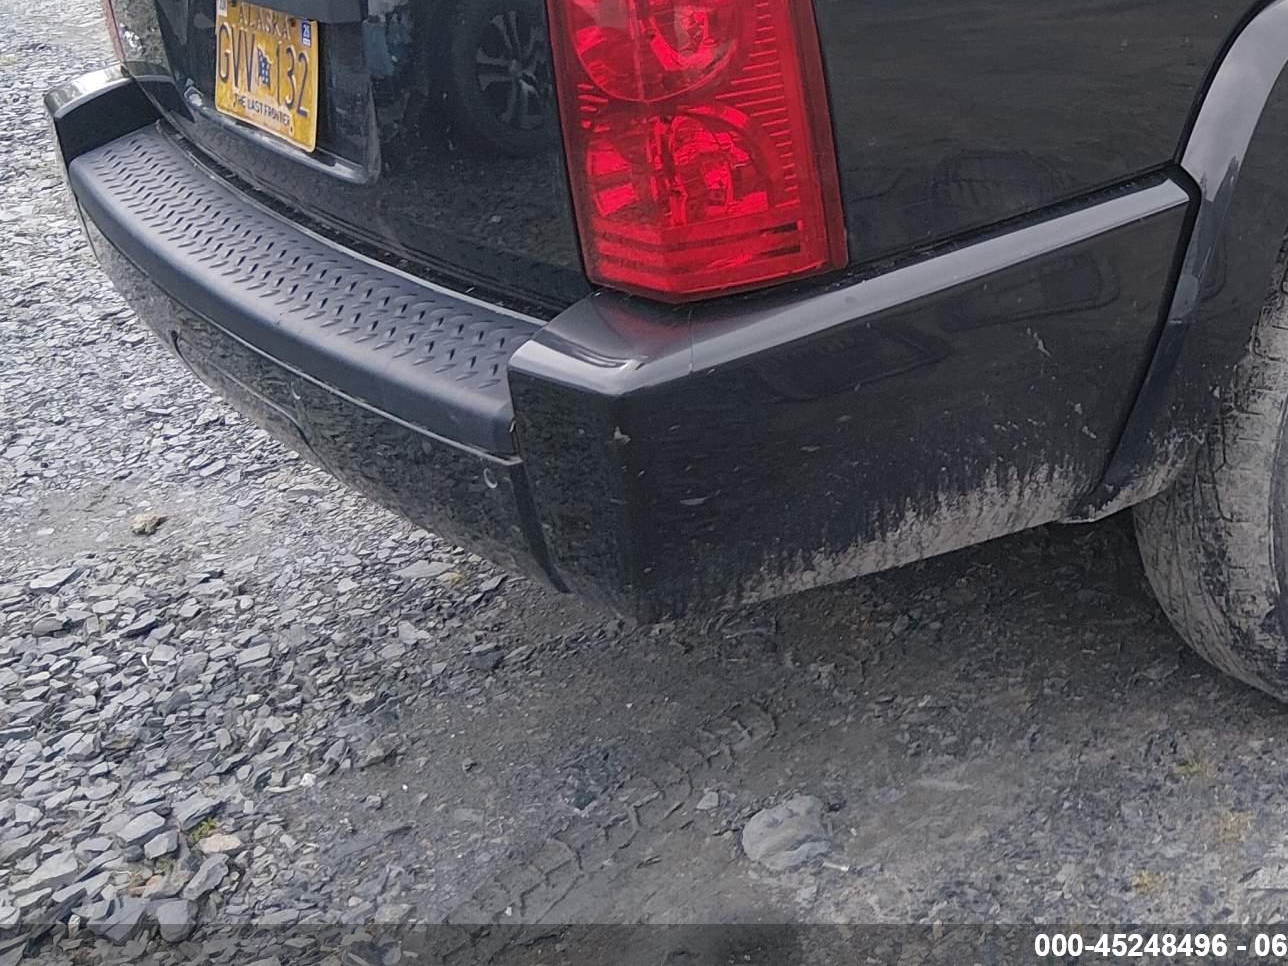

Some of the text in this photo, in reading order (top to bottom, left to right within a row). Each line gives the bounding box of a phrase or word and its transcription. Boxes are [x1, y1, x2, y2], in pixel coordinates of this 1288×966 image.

[239, 3, 291, 41] ALASKA
[218, 22, 256, 93] GVV
[275, 42, 308, 118] 132
[234, 93, 247, 108] THE
[247, 98, 263, 115] LAST
